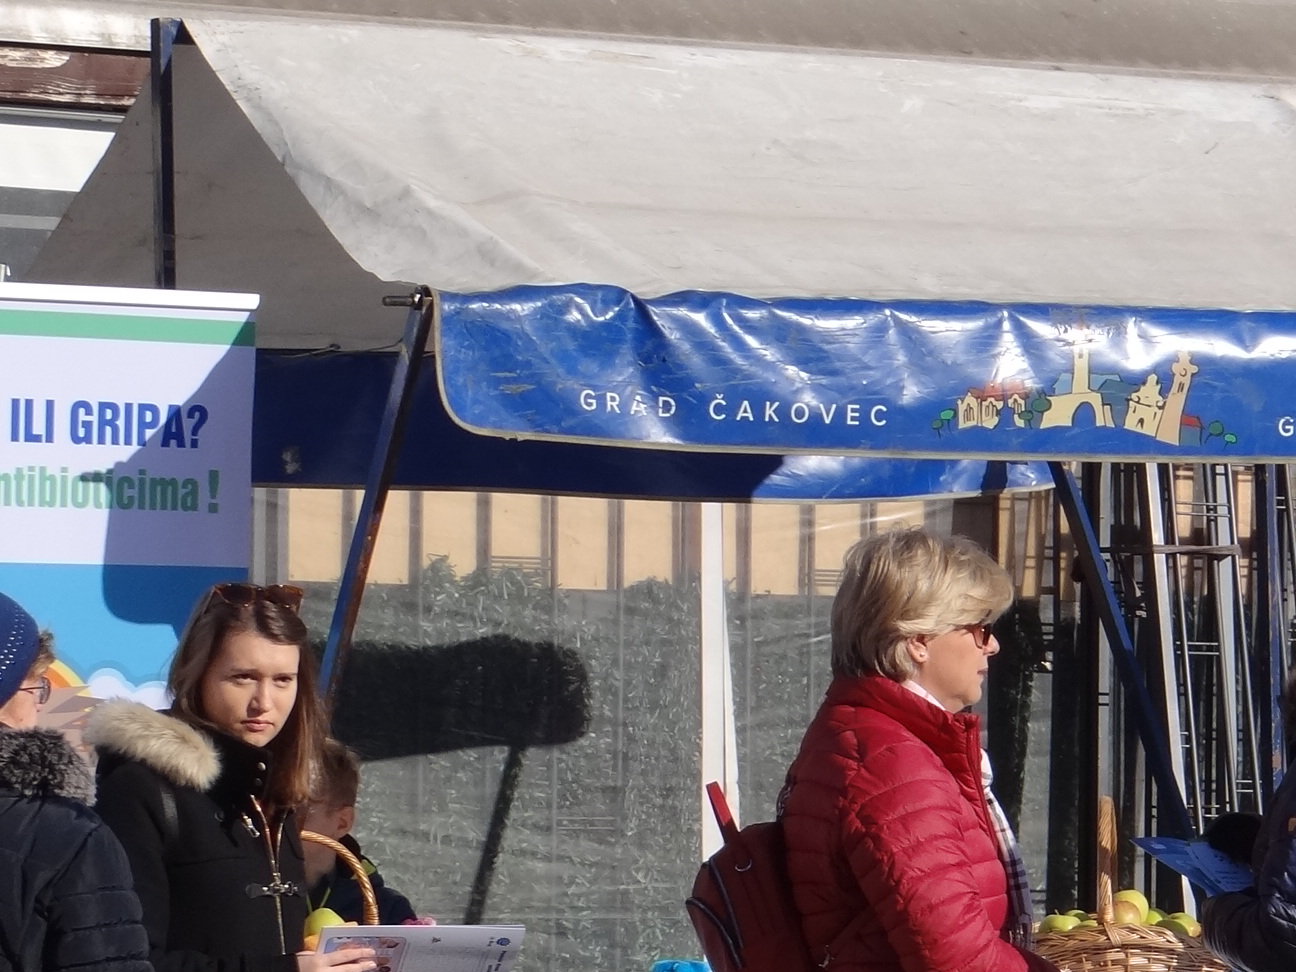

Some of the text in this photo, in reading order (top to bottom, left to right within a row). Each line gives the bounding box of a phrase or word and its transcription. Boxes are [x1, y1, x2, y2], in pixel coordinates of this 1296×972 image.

[10, 398, 209, 449] ILI GRIPA?
[580, 390, 889, 426] GRAD ČAKOVEC
